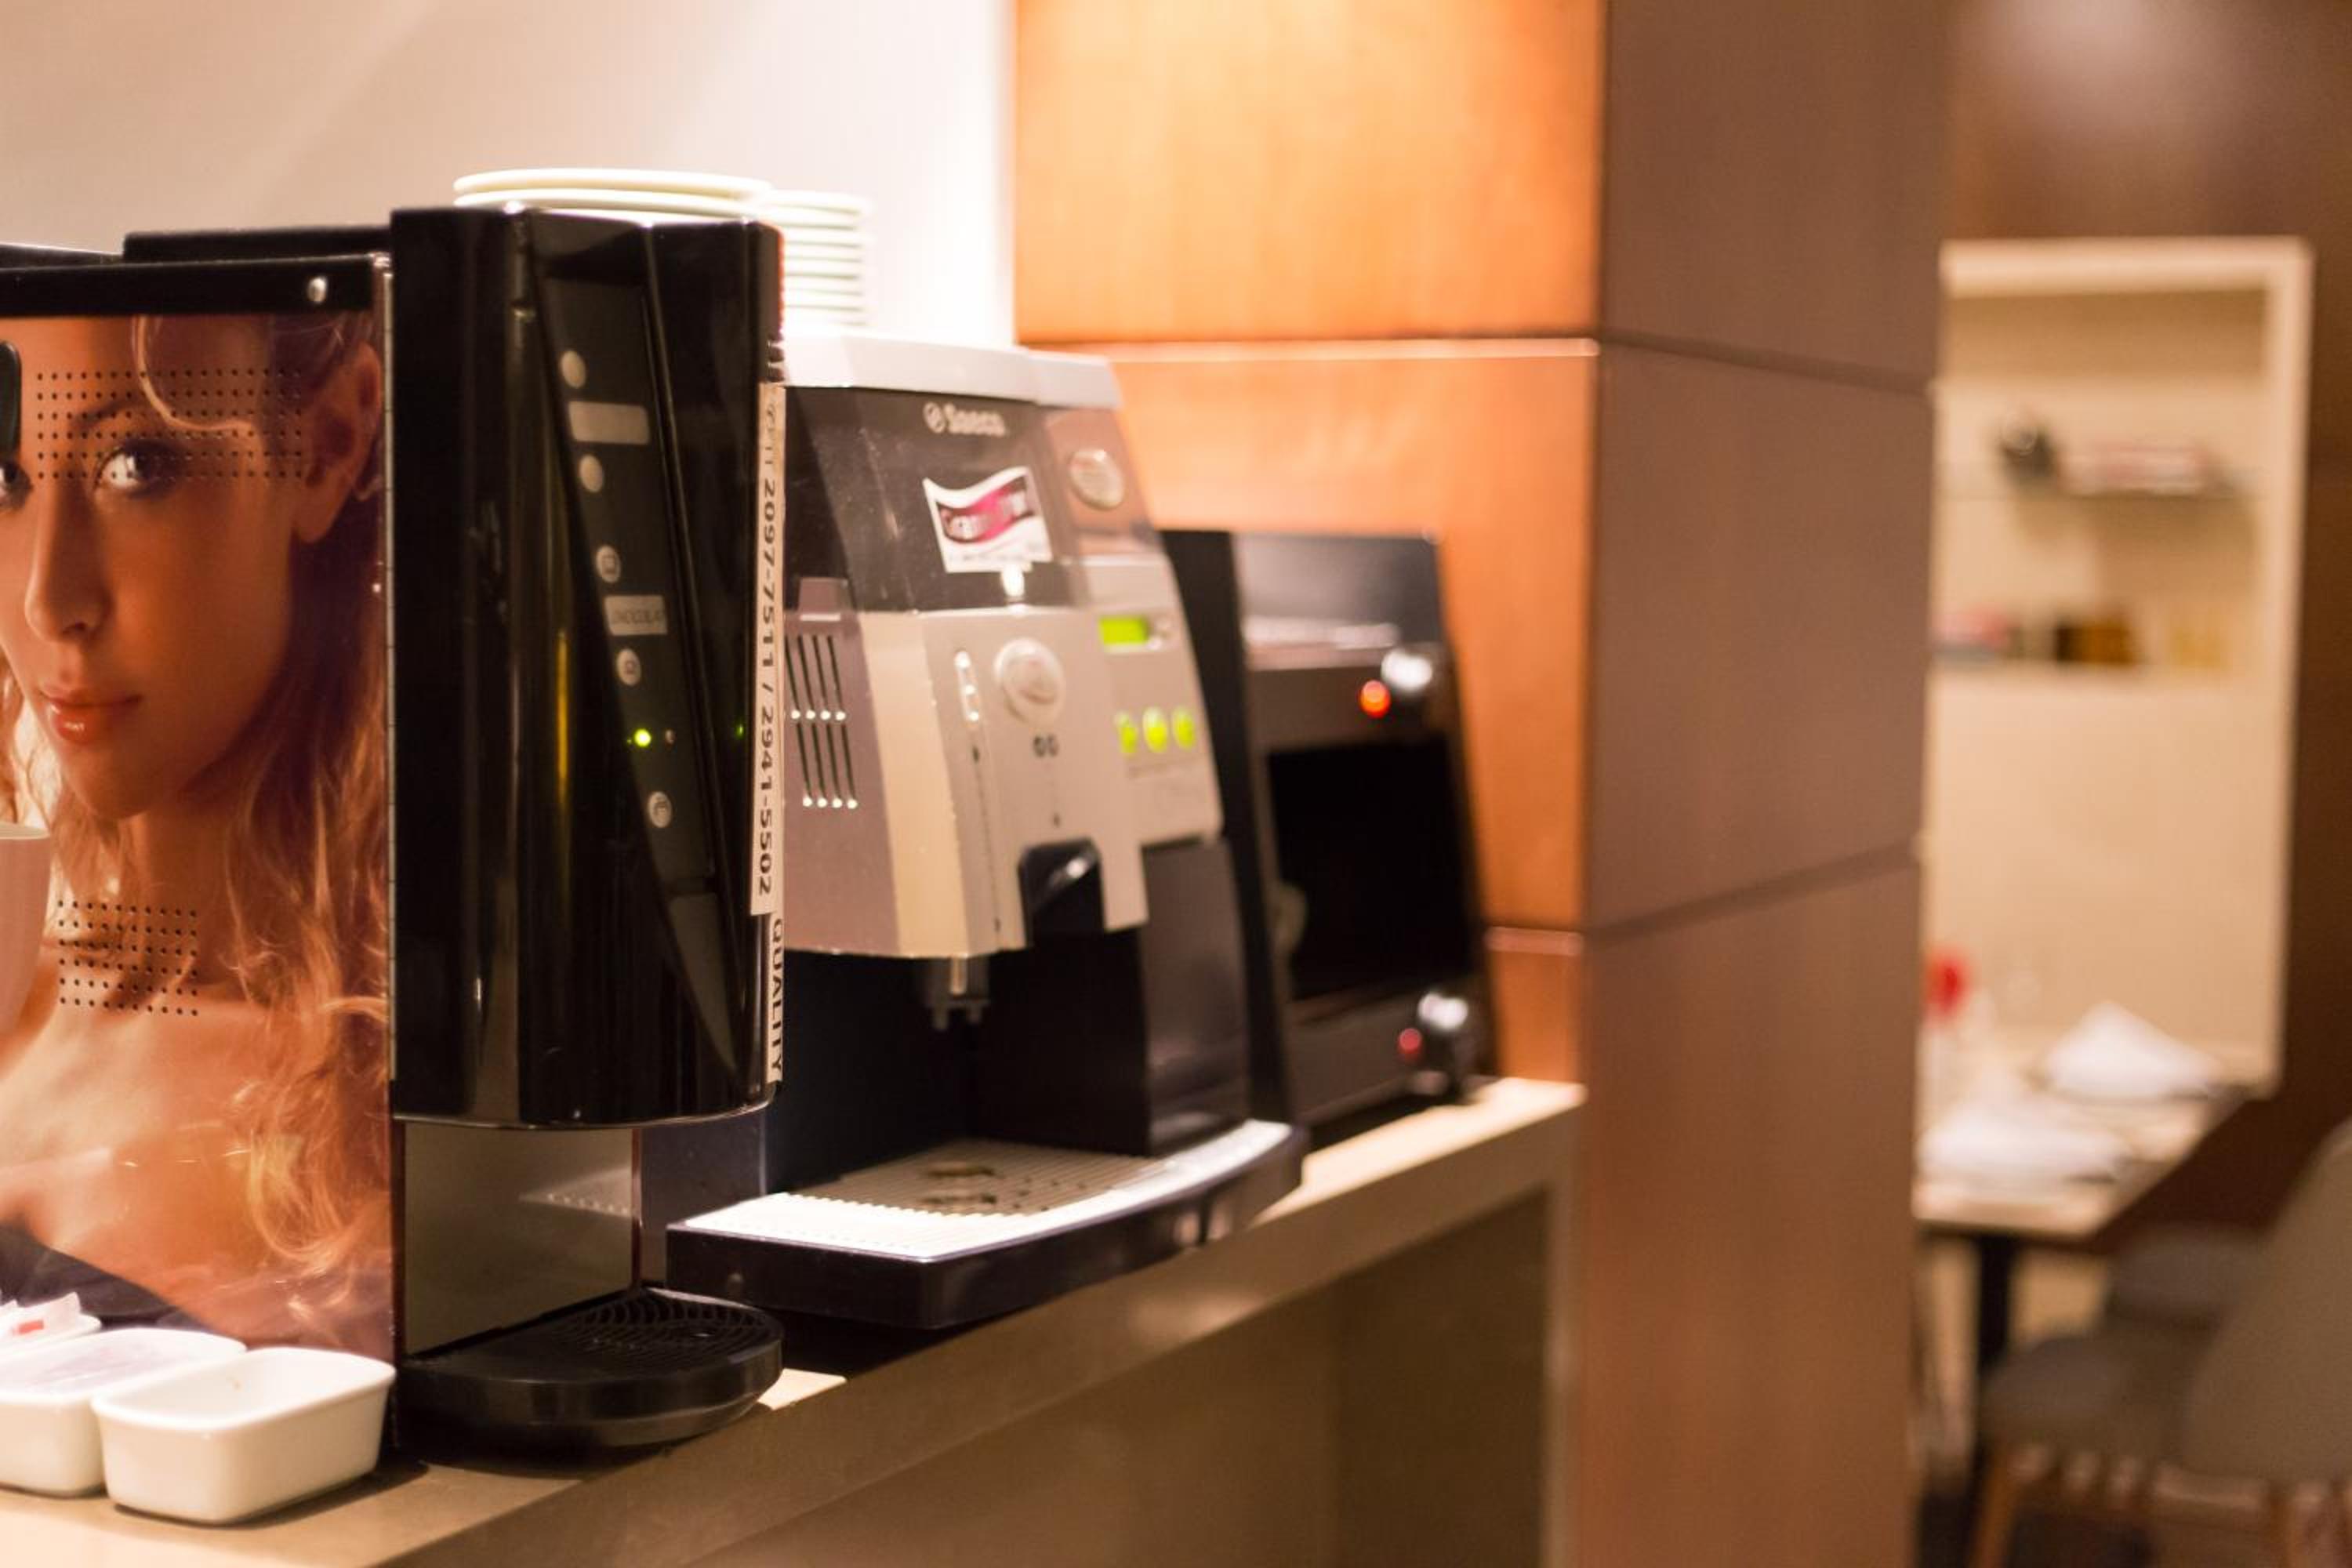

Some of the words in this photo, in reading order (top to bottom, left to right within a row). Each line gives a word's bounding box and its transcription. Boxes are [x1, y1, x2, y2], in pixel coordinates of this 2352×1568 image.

[763, 478, 775, 666] 2097-7511
[762, 682, 774, 693] /
[759, 707, 773, 895] 2941-5502
[771, 917, 782, 1074] QUALITY
